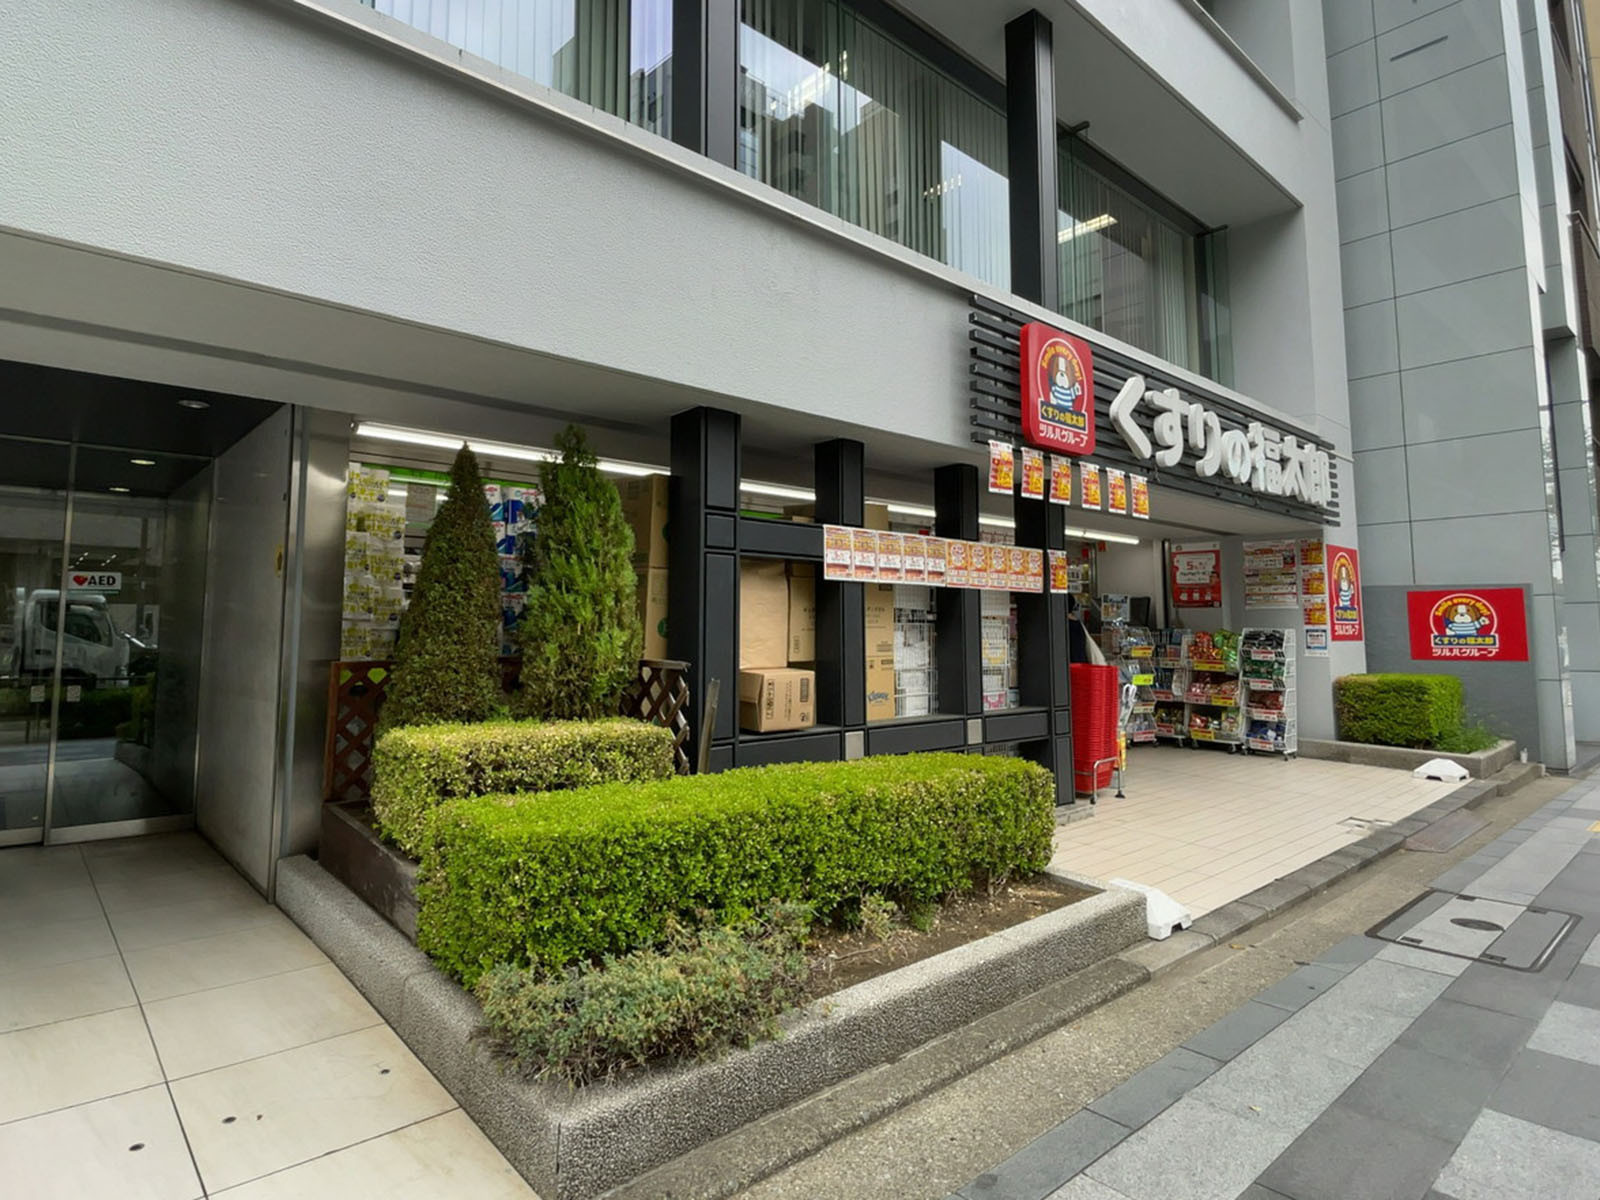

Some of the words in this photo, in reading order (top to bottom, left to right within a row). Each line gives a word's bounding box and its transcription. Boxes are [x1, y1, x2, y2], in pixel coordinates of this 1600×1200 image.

[1109, 374, 1331, 507] くすりの福太郎
[88, 575, 117, 586] AED
